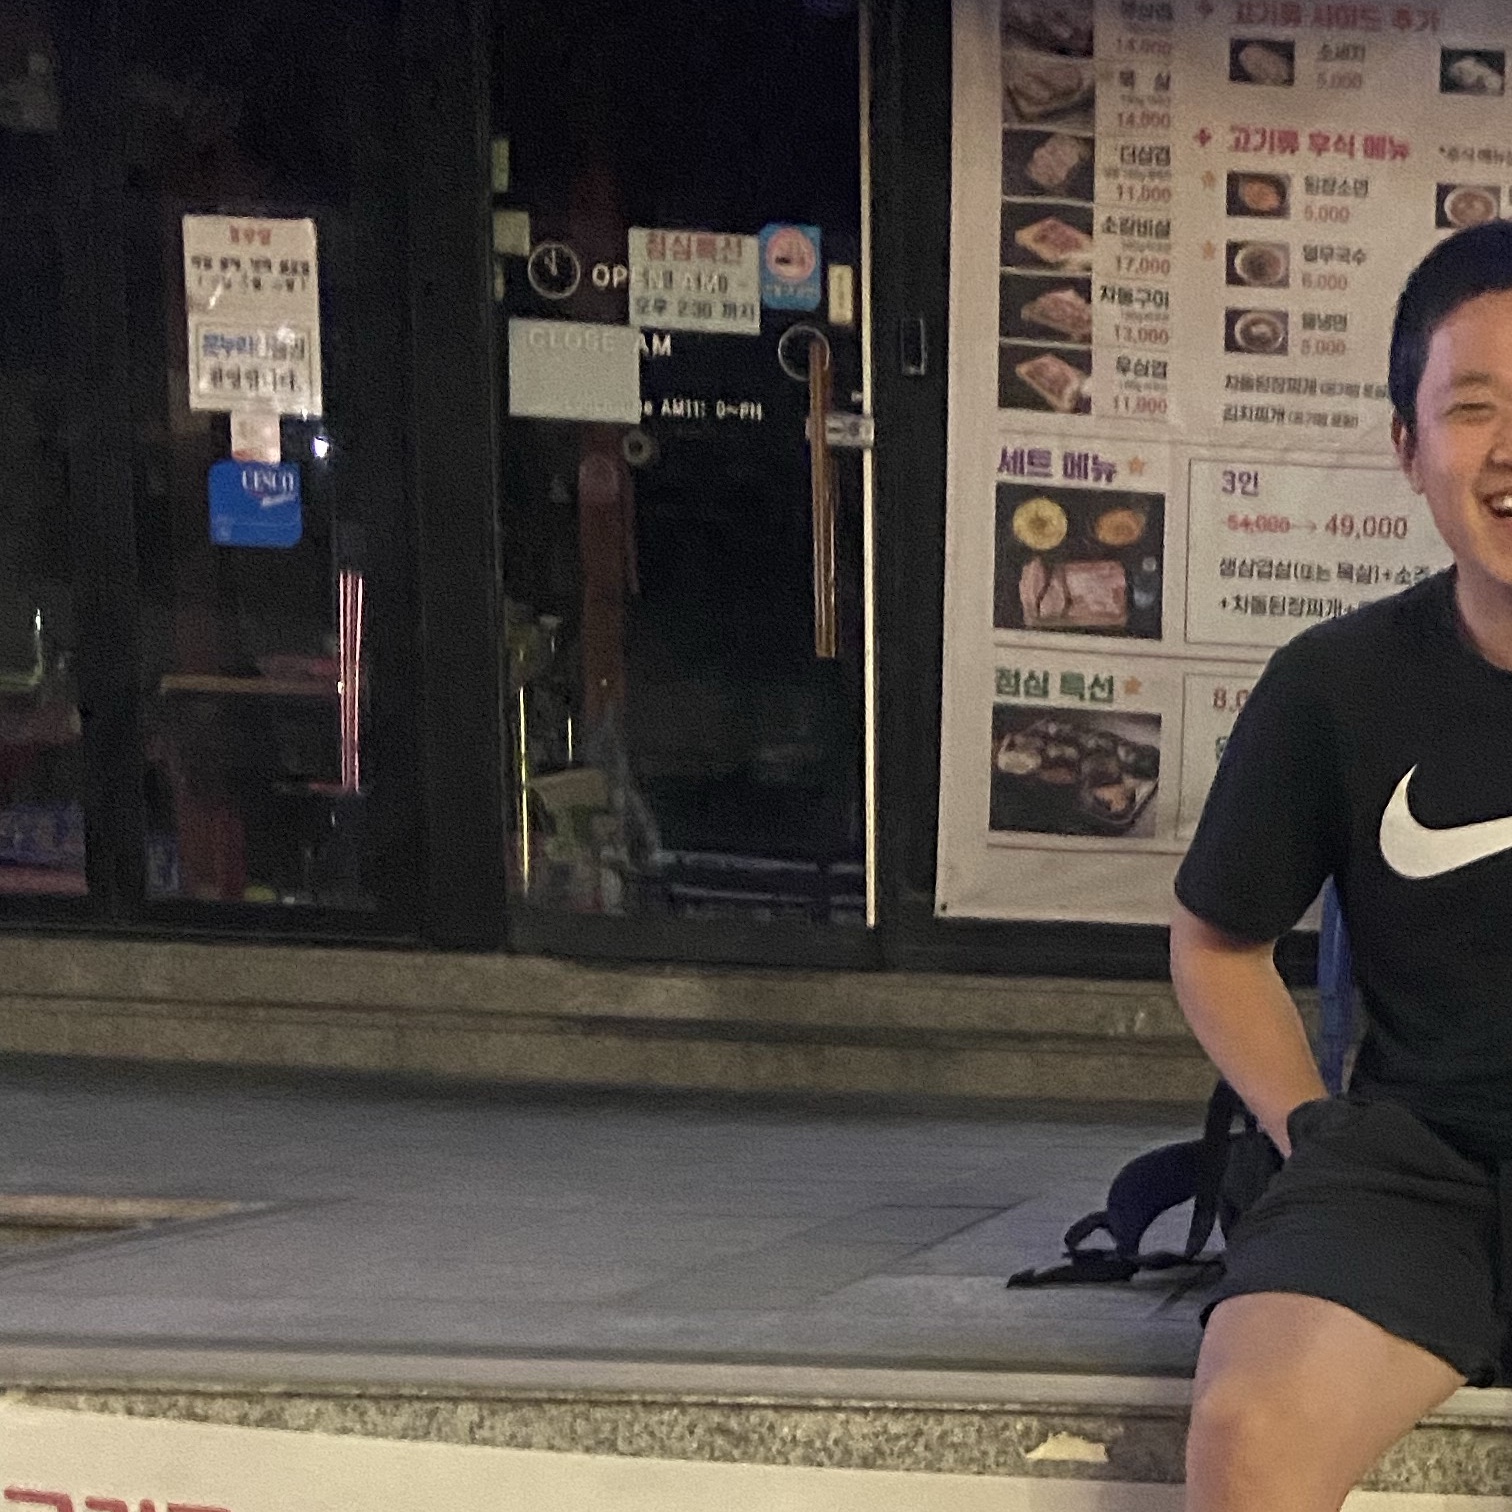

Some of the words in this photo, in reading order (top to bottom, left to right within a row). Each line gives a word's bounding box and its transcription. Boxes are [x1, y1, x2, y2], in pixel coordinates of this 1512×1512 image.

[997, 446, 1053, 479] 세트
[1062, 452, 1117, 482] 메뉴
[1222, 470, 1259, 497] 3인
[1325, 513, 1408, 539] 49,000
